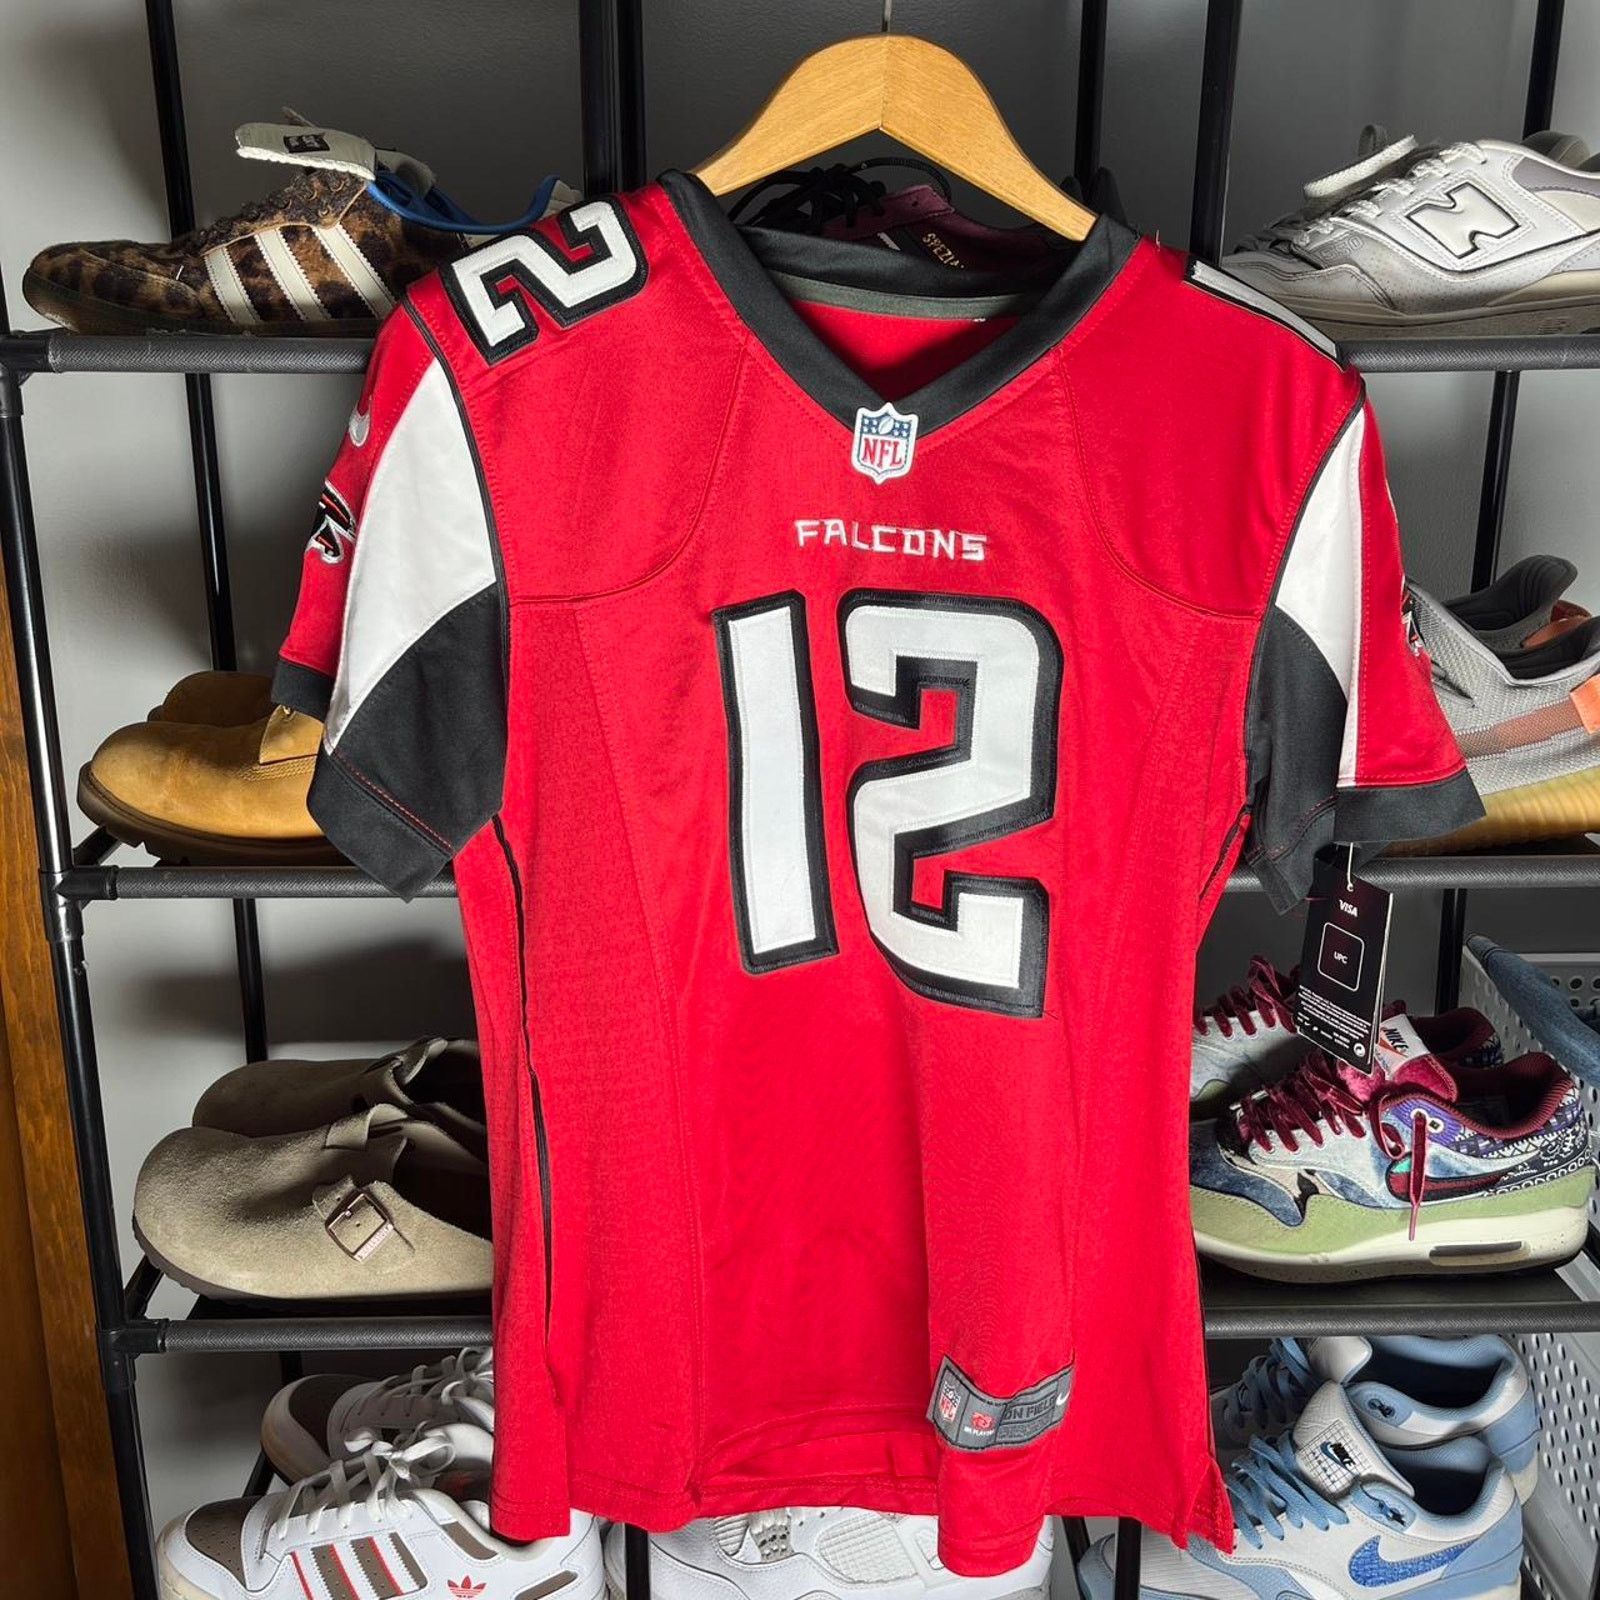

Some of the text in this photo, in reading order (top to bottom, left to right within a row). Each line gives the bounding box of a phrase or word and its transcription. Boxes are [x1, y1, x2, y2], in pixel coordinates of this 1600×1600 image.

[922, 232, 965, 269] SPEZIA
[861, 437, 903, 468] NFL
[794, 518, 987, 561] FALCONS
[711, 587, 1064, 1018] 12
[1339, 899, 1359, 917] VISA
[1333, 951, 1348, 965] UPC
[1383, 1028, 1409, 1052] NIKE
[1004, 1394, 1058, 1420] ON FIELD
[1330, 1441, 1357, 1467] NIKE
